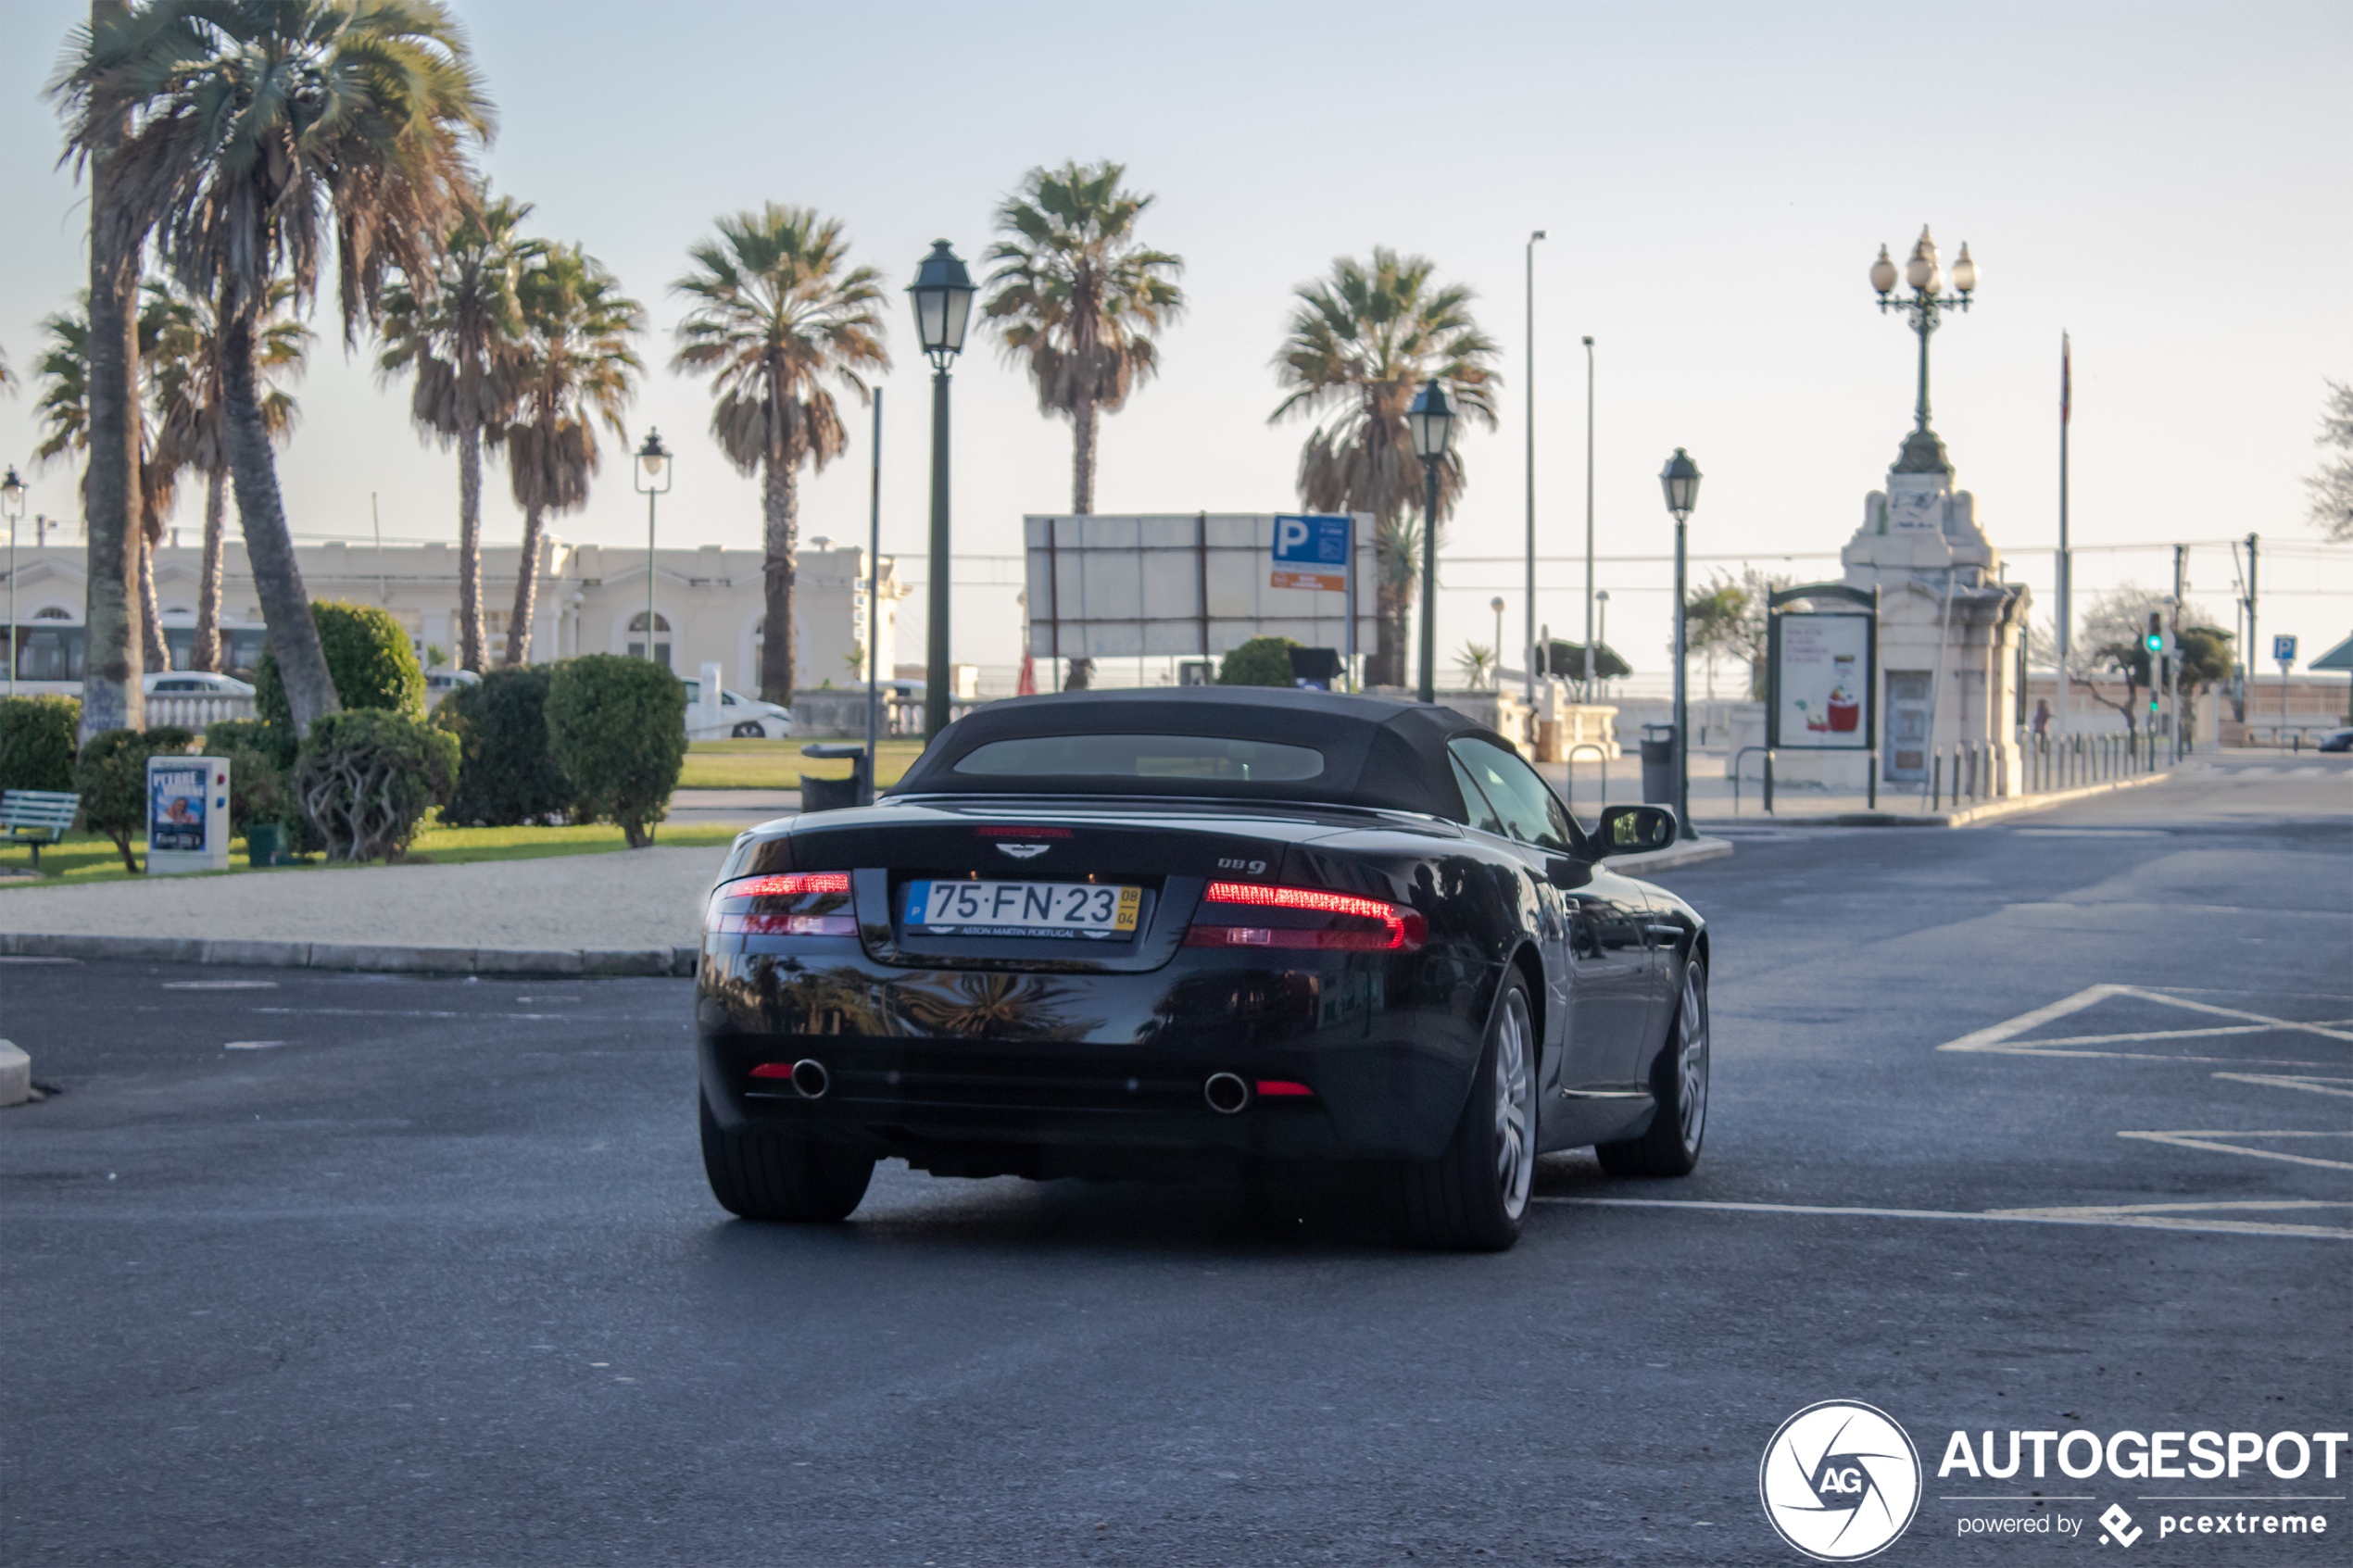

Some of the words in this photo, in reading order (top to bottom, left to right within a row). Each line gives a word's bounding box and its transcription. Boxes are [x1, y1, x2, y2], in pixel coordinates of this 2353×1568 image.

[1277, 519, 1309, 557] P
[2278, 638, 2292, 658] P
[1122, 889, 1139, 902] 08
[911, 906, 921, 917] P
[1117, 912, 1134, 925] 04
[962, 926, 991, 935] ASTON
[992, 927, 1026, 937] MARTIN
[1027, 928, 1075, 938] PORTUGAL
